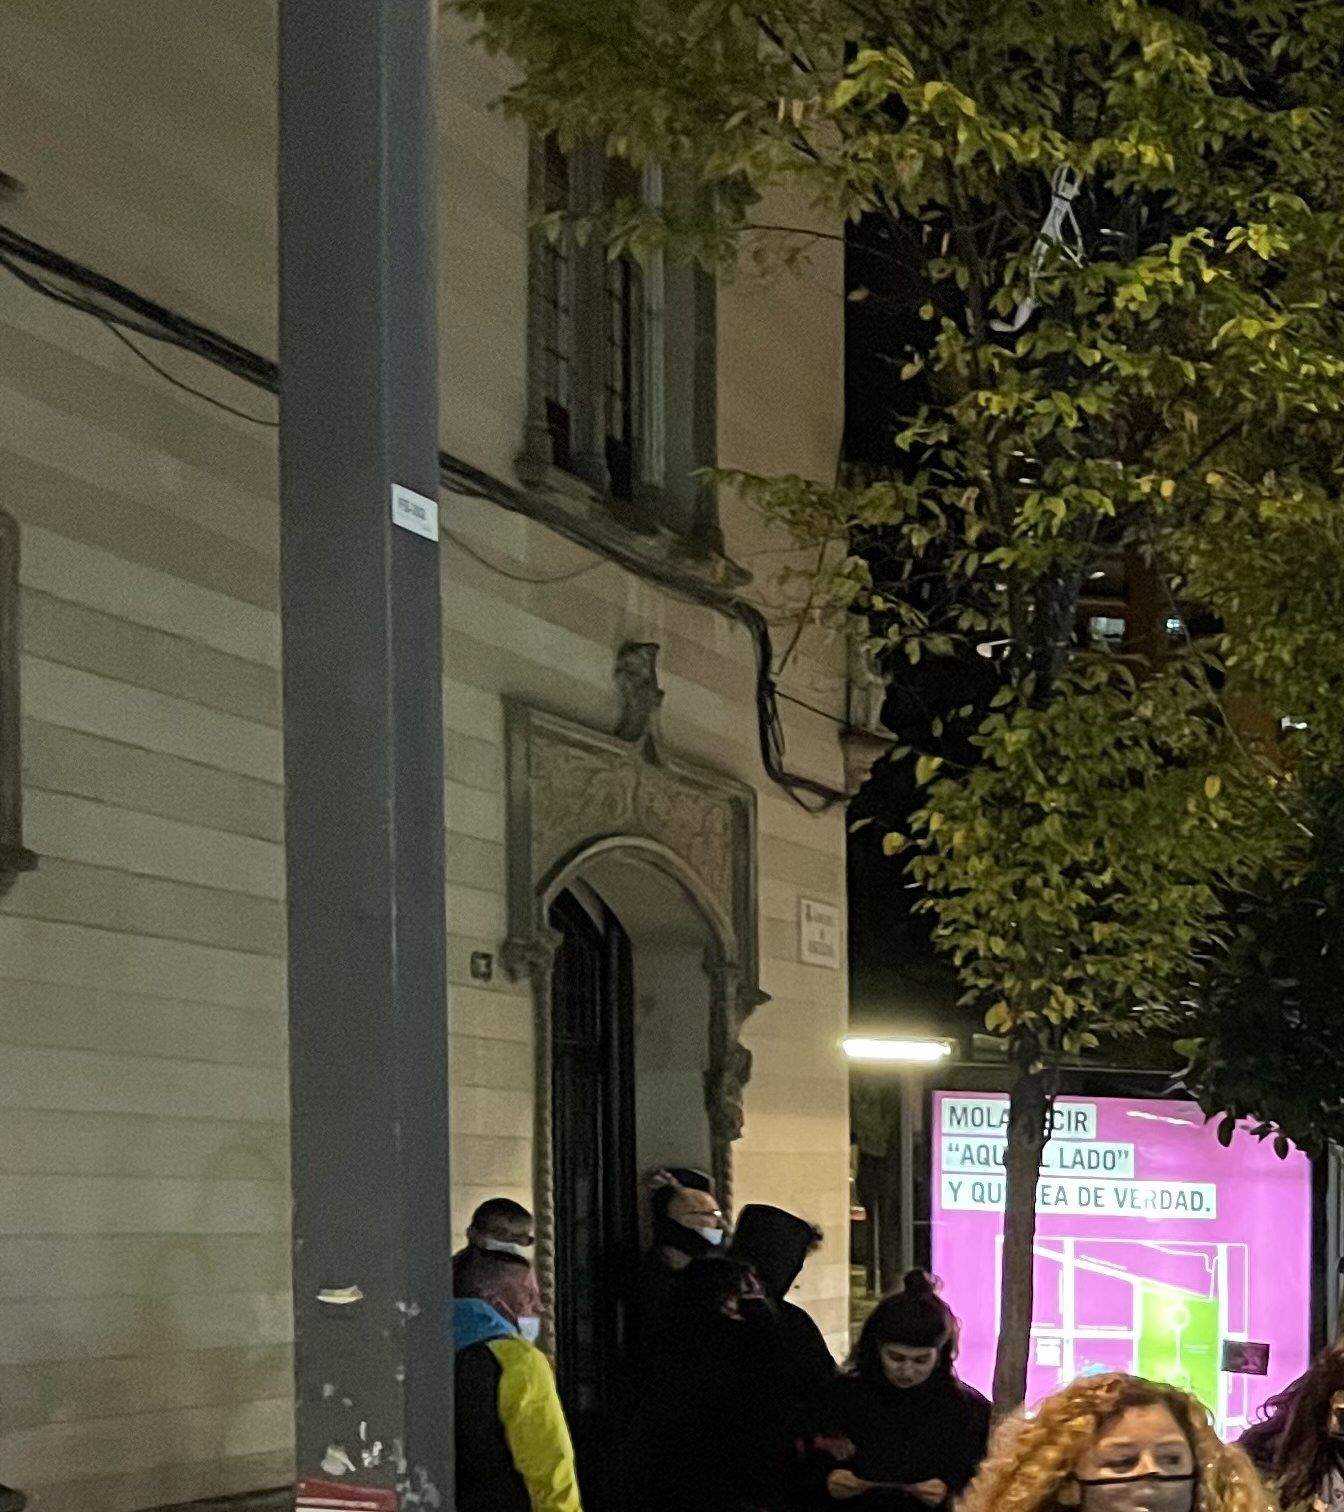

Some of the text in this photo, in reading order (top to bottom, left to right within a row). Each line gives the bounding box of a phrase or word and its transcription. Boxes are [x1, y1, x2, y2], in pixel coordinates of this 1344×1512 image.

[948, 1180, 1212, 1213] Y QU EA DE VERDAD.
